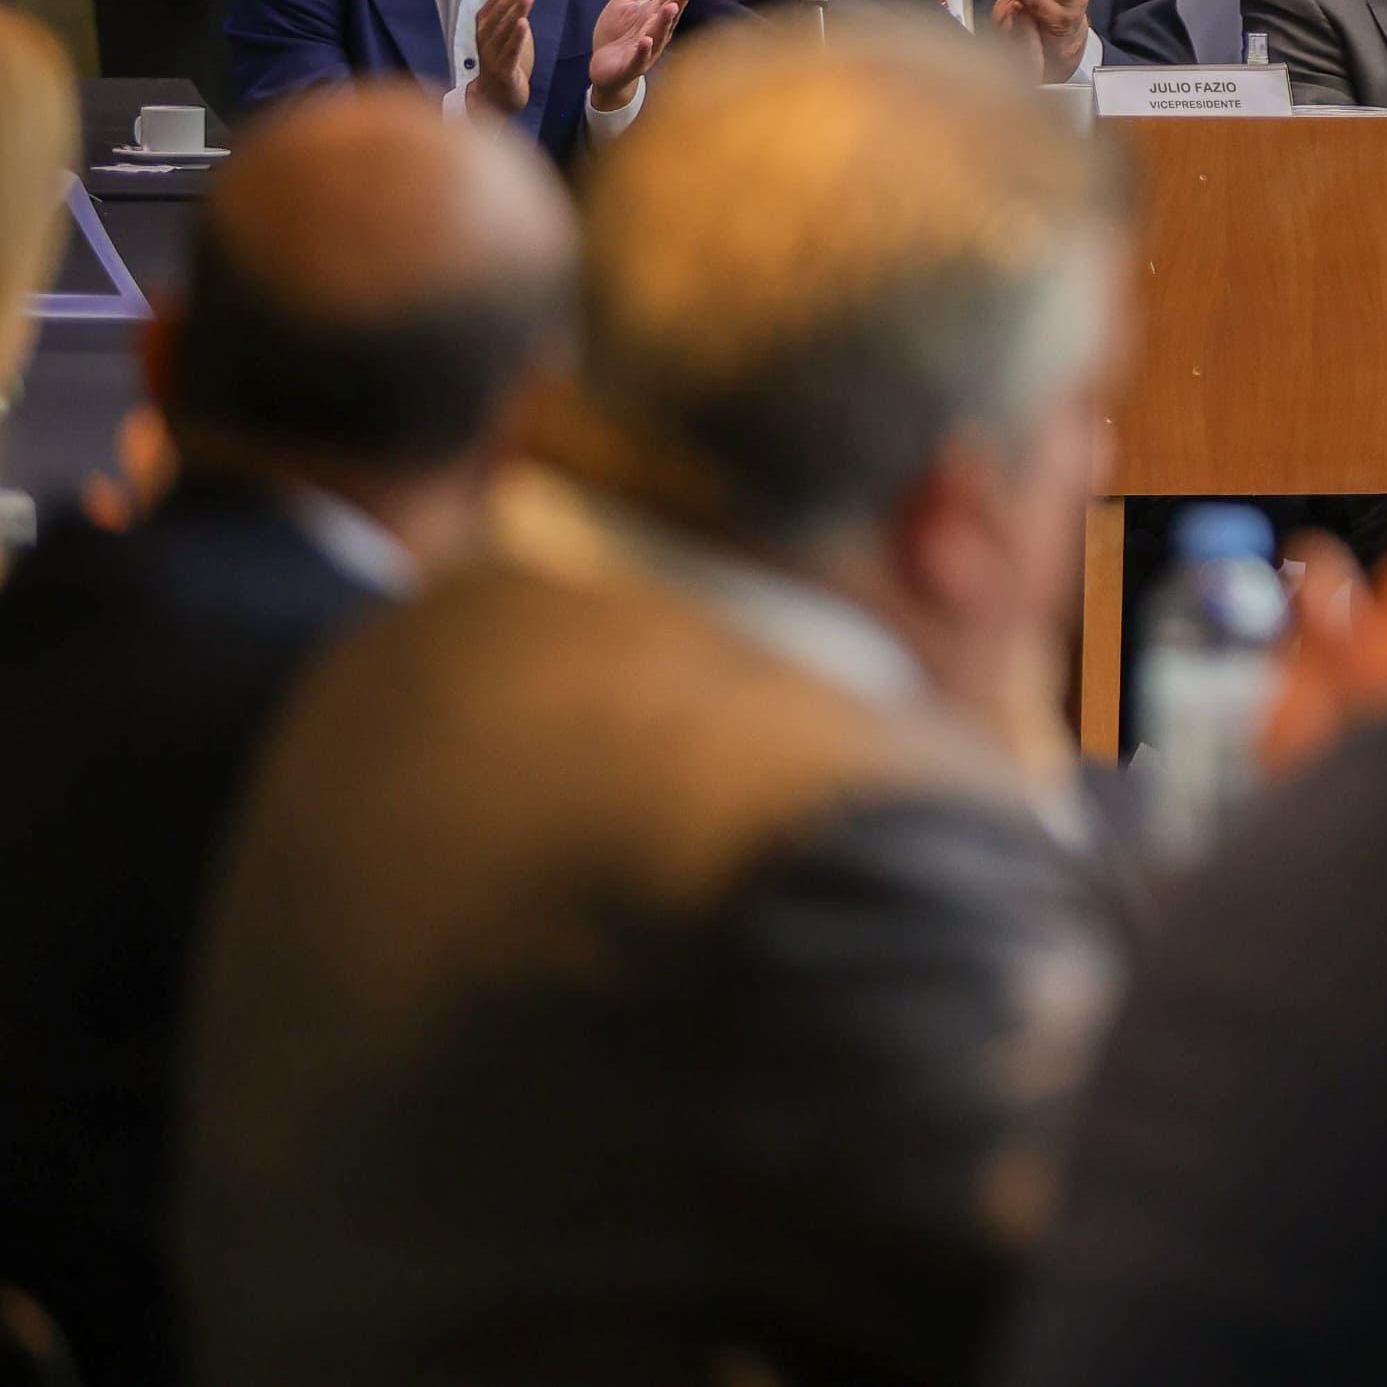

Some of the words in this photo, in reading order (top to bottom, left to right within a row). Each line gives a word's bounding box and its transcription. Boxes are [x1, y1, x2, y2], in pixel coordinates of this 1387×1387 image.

[1149, 81, 1191, 94] JULIO
[1195, 81, 1237, 94] FAZIO
[1149, 99, 1242, 110] VICEPRESIDENTE
